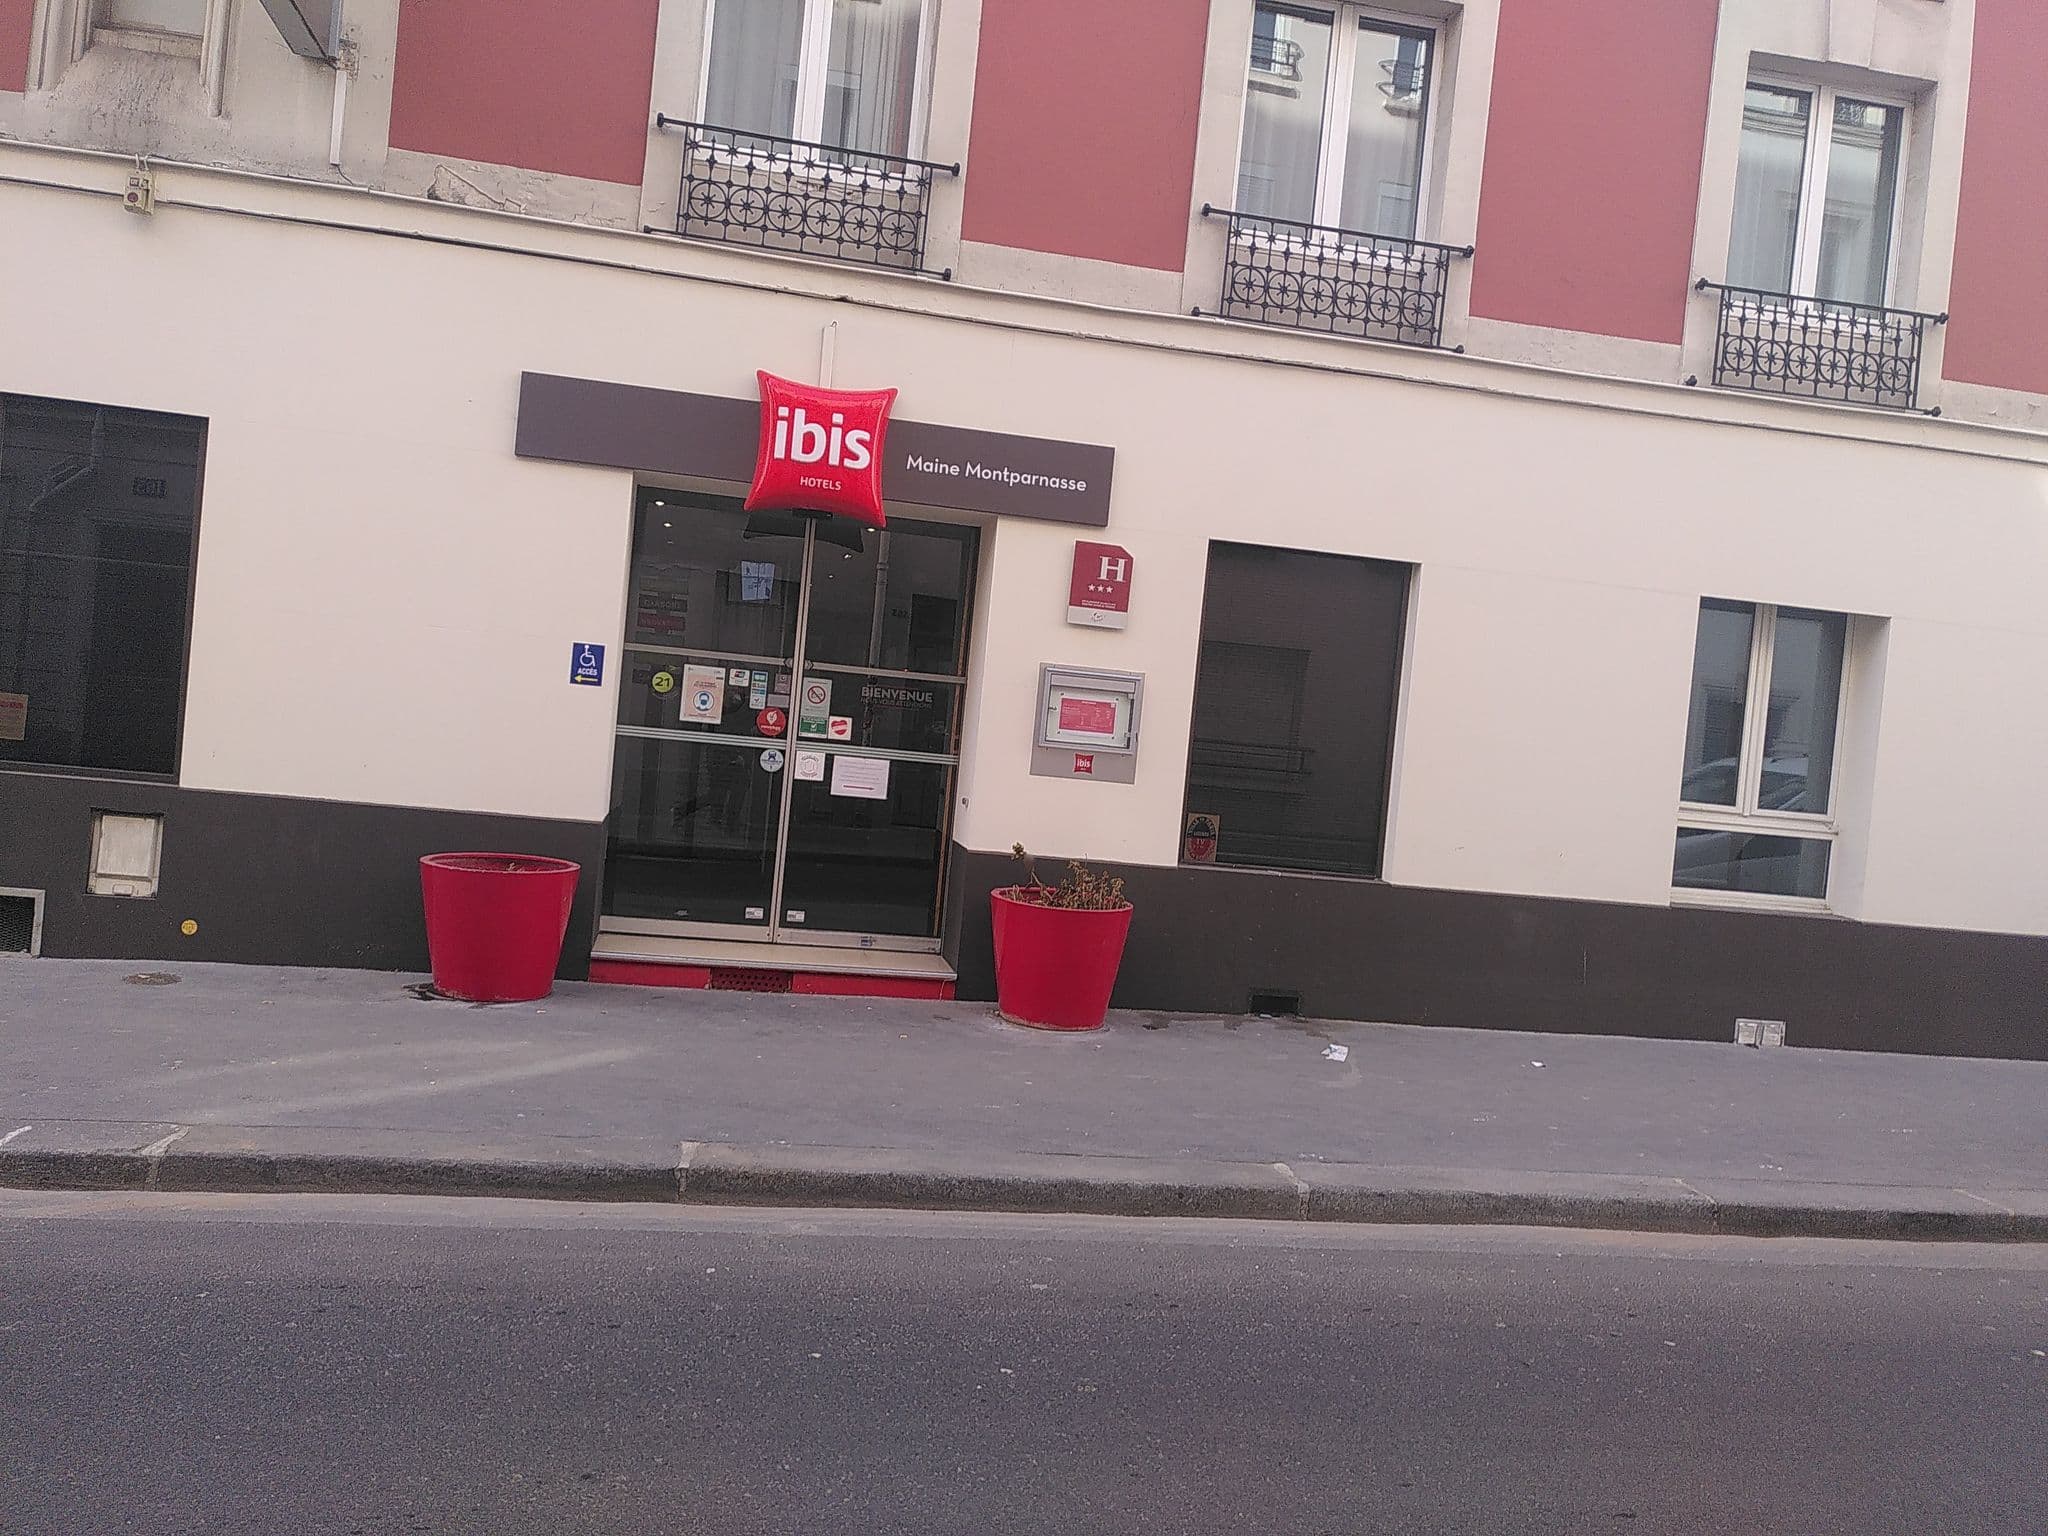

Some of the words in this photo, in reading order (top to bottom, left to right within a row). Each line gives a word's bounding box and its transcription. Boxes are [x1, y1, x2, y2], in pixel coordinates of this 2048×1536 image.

[773, 406, 871, 470] ibis
[905, 454, 960, 476] Maine
[965, 461, 1087, 492] Montparnasse
[799, 476, 842, 491] HOTELS
[1097, 556, 1129, 582] H
[655, 677, 671, 687] 21
[861, 686, 933, 703] BIENVENUE
[1076, 758, 1091, 768] ibis
